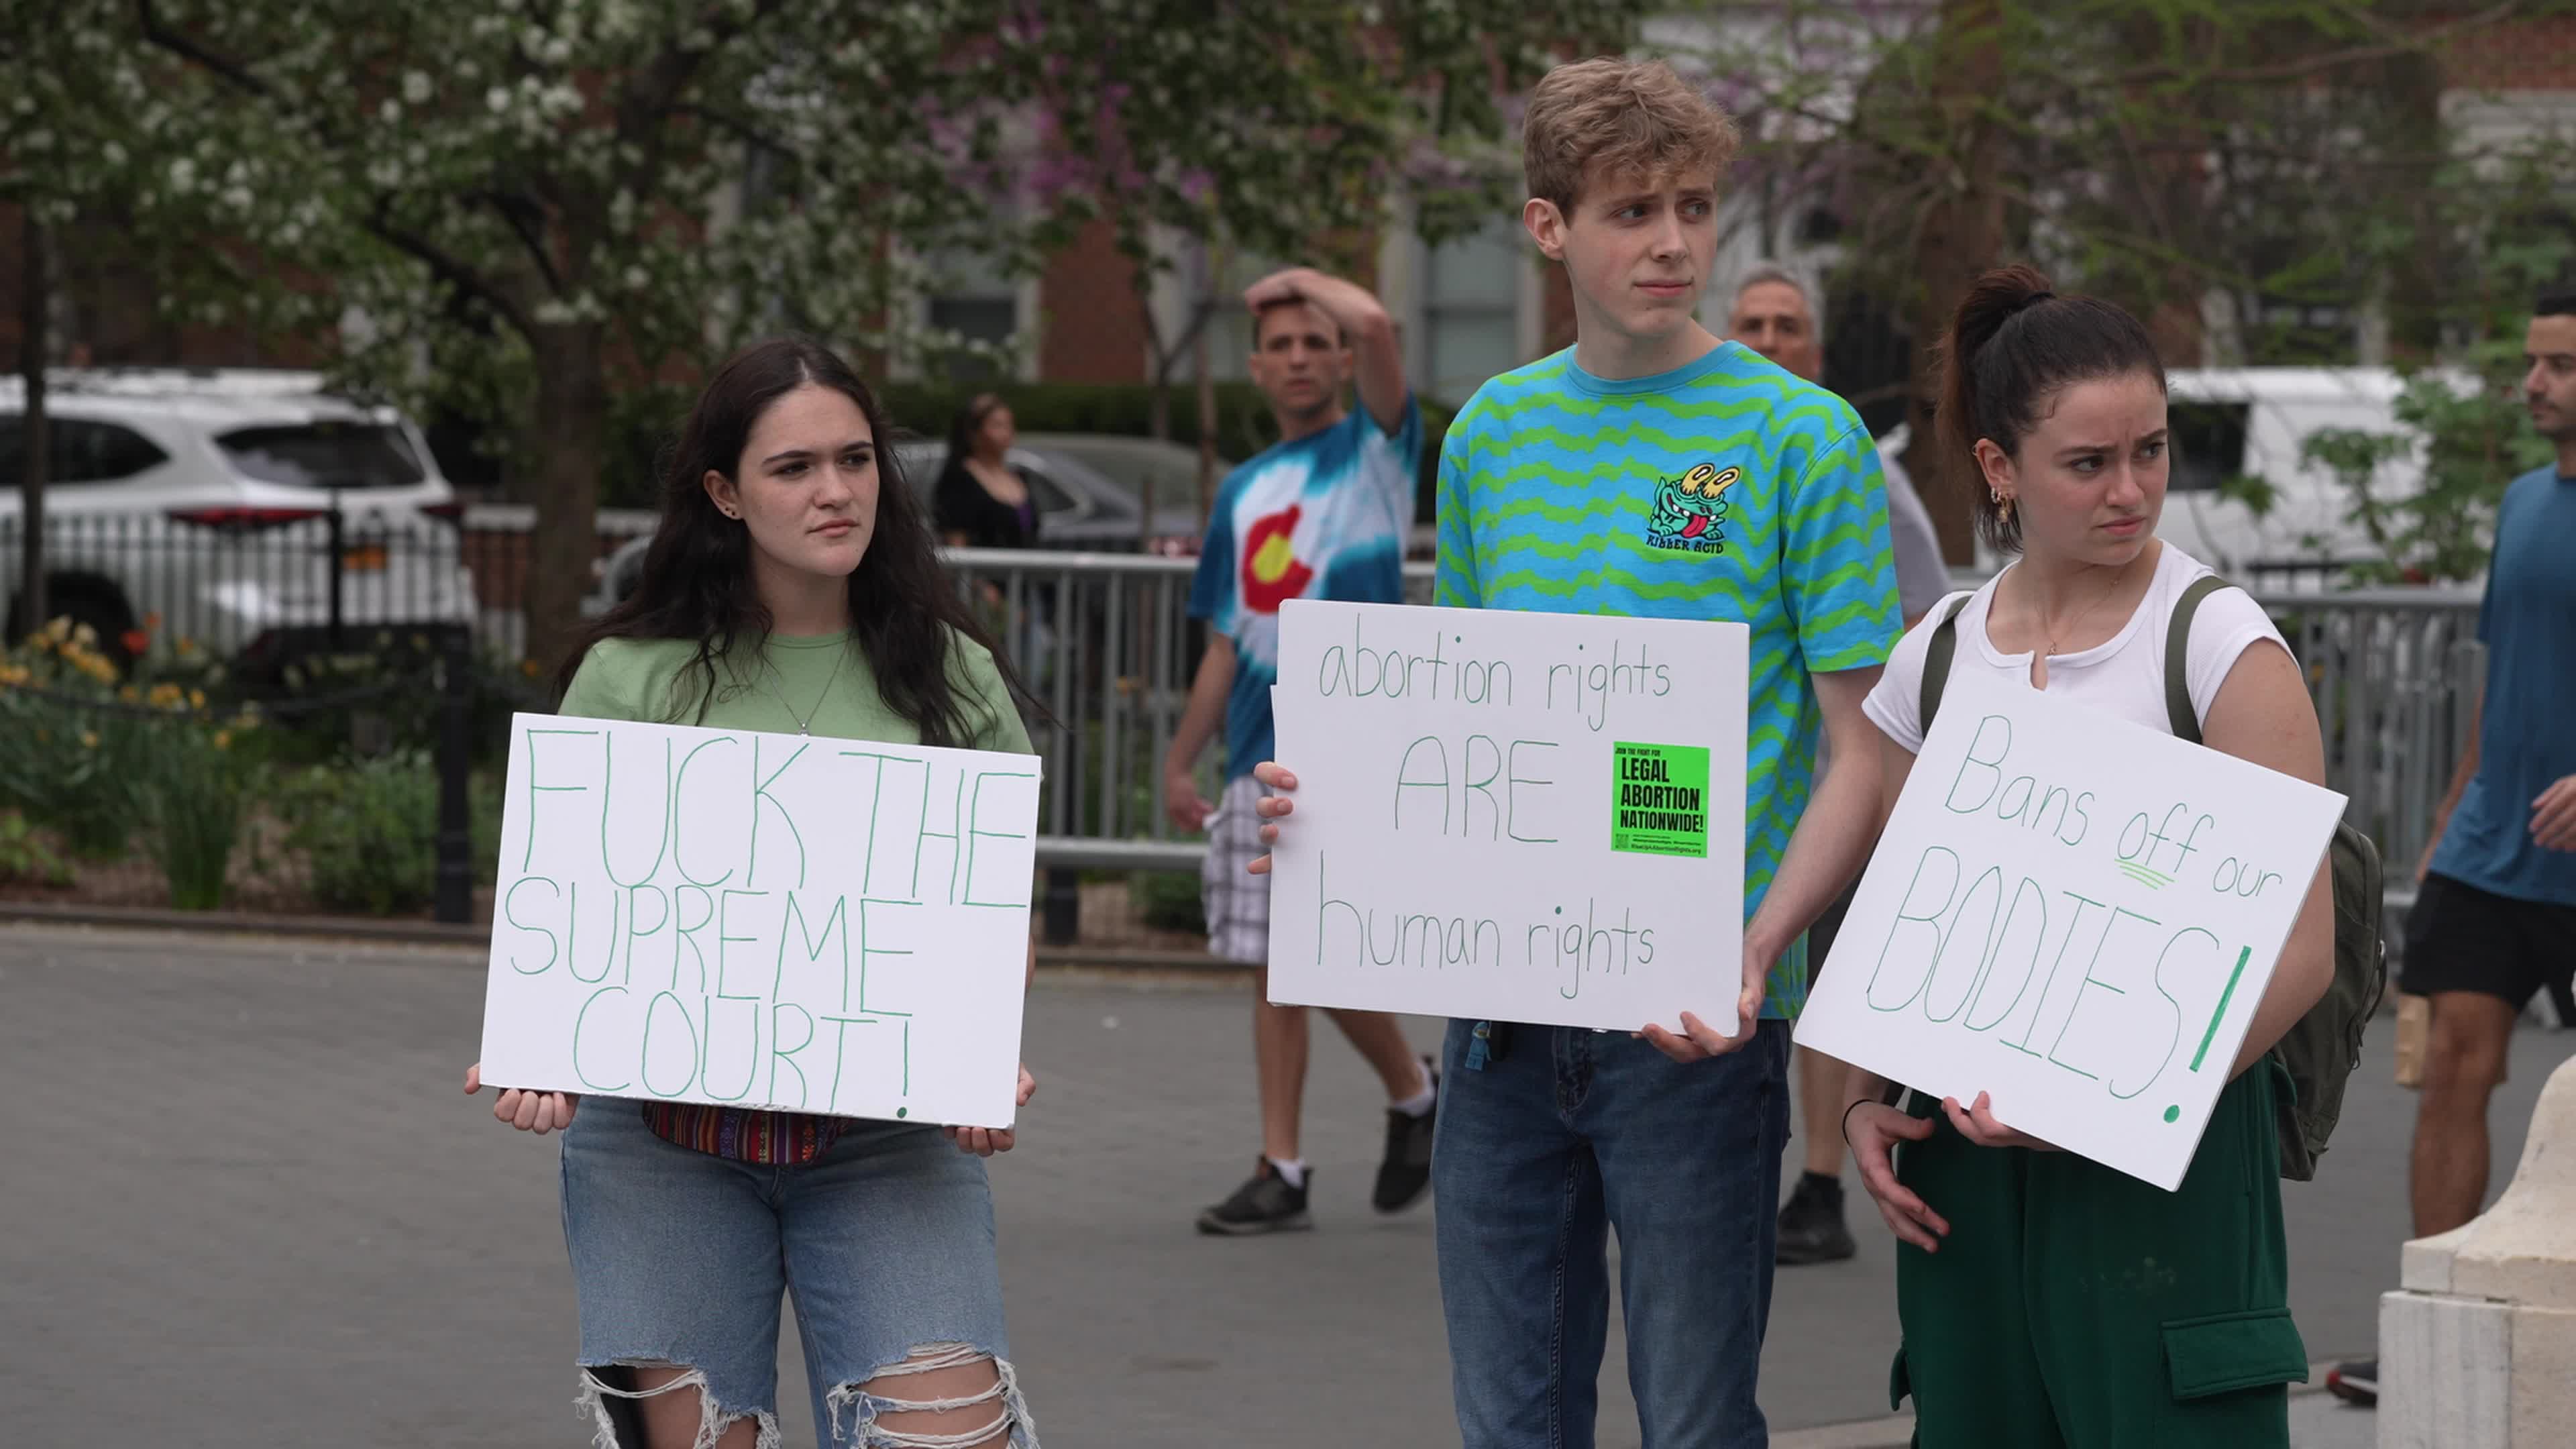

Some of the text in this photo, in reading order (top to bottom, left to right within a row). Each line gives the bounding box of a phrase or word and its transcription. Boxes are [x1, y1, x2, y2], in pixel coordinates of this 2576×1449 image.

[1694, 541, 1723, 553] ACID
[1319, 613, 1672, 732] abortion rights
[523, 729, 1036, 908] FUCK THE
[1395, 735, 1559, 843] ARE
[1620, 810, 1703, 833] NATIONWIDE!
[1621, 757, 1670, 782] LEGAL
[1621, 784, 1700, 811] ABORTION
[1945, 714, 2282, 898] Bans off our
[506, 876, 923, 1018] SUPREME
[1318, 849, 1654, 1000] human rights
[1866, 846, 2252, 1124] BODIES!
[574, 986, 908, 1119] COURT!
